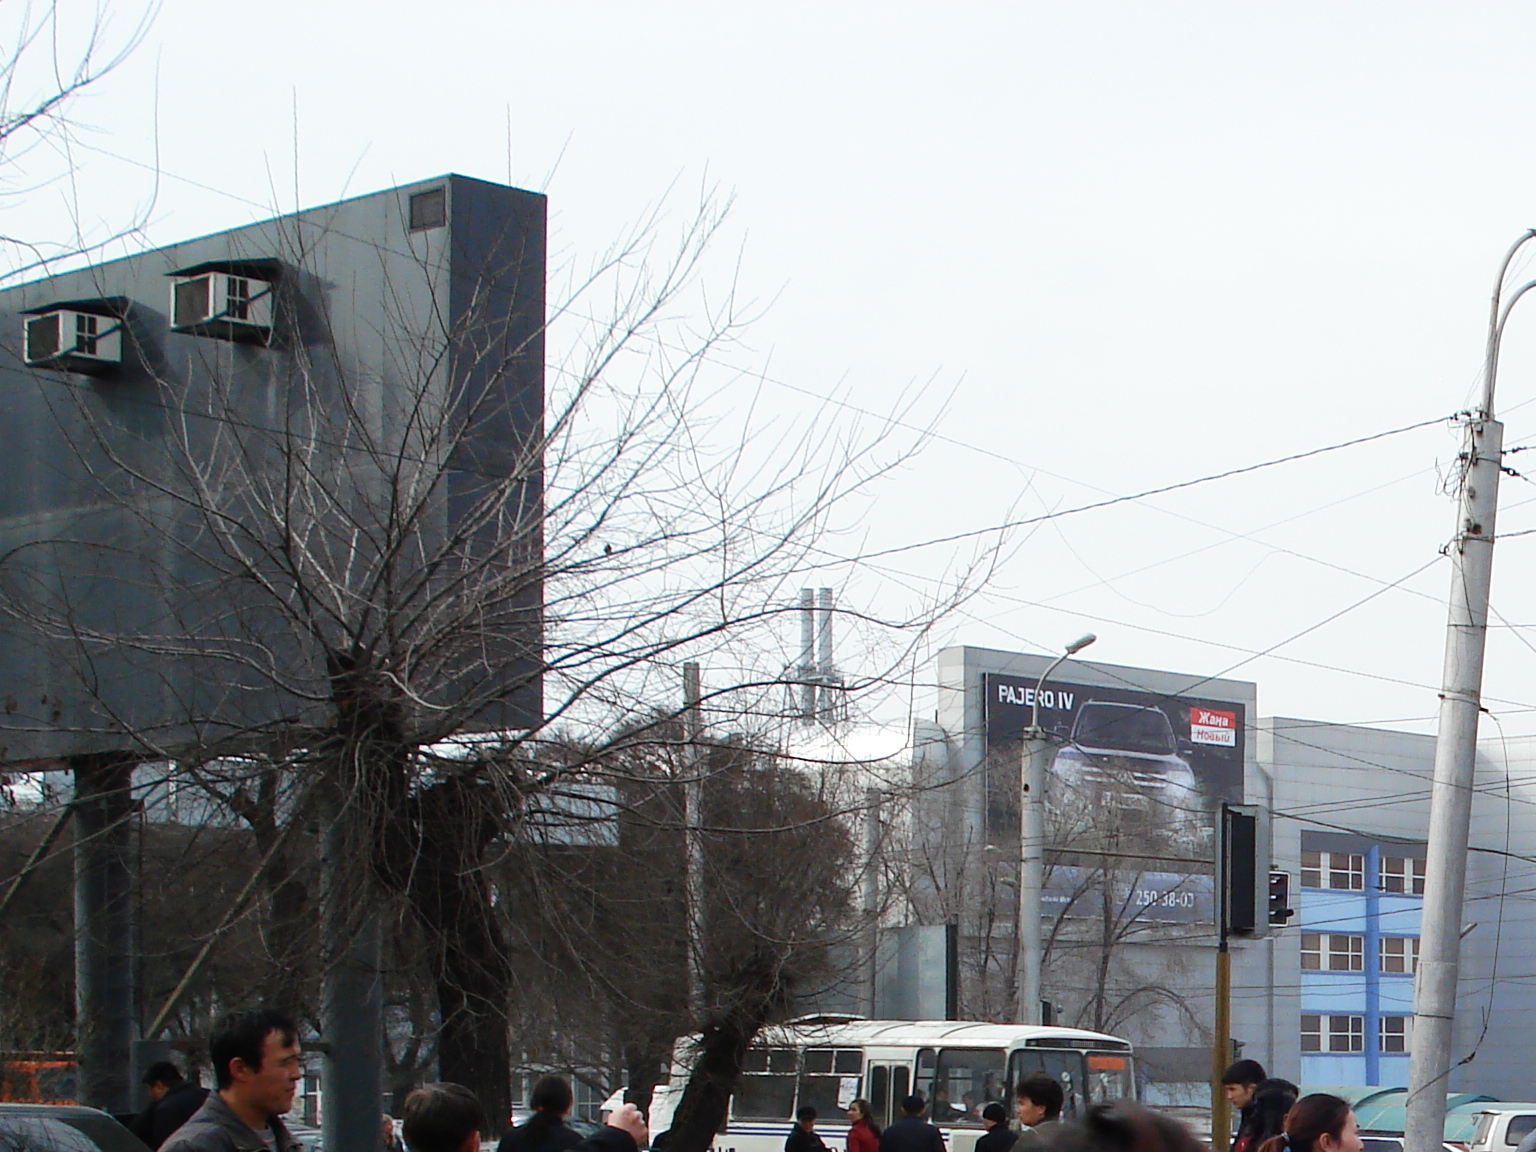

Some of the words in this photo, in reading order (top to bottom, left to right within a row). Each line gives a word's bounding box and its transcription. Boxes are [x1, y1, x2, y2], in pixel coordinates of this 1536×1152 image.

[998, 684, 1055, 709] PAJERO
[1057, 691, 1074, 710] IV
[1196, 729, 1230, 743] Новый
